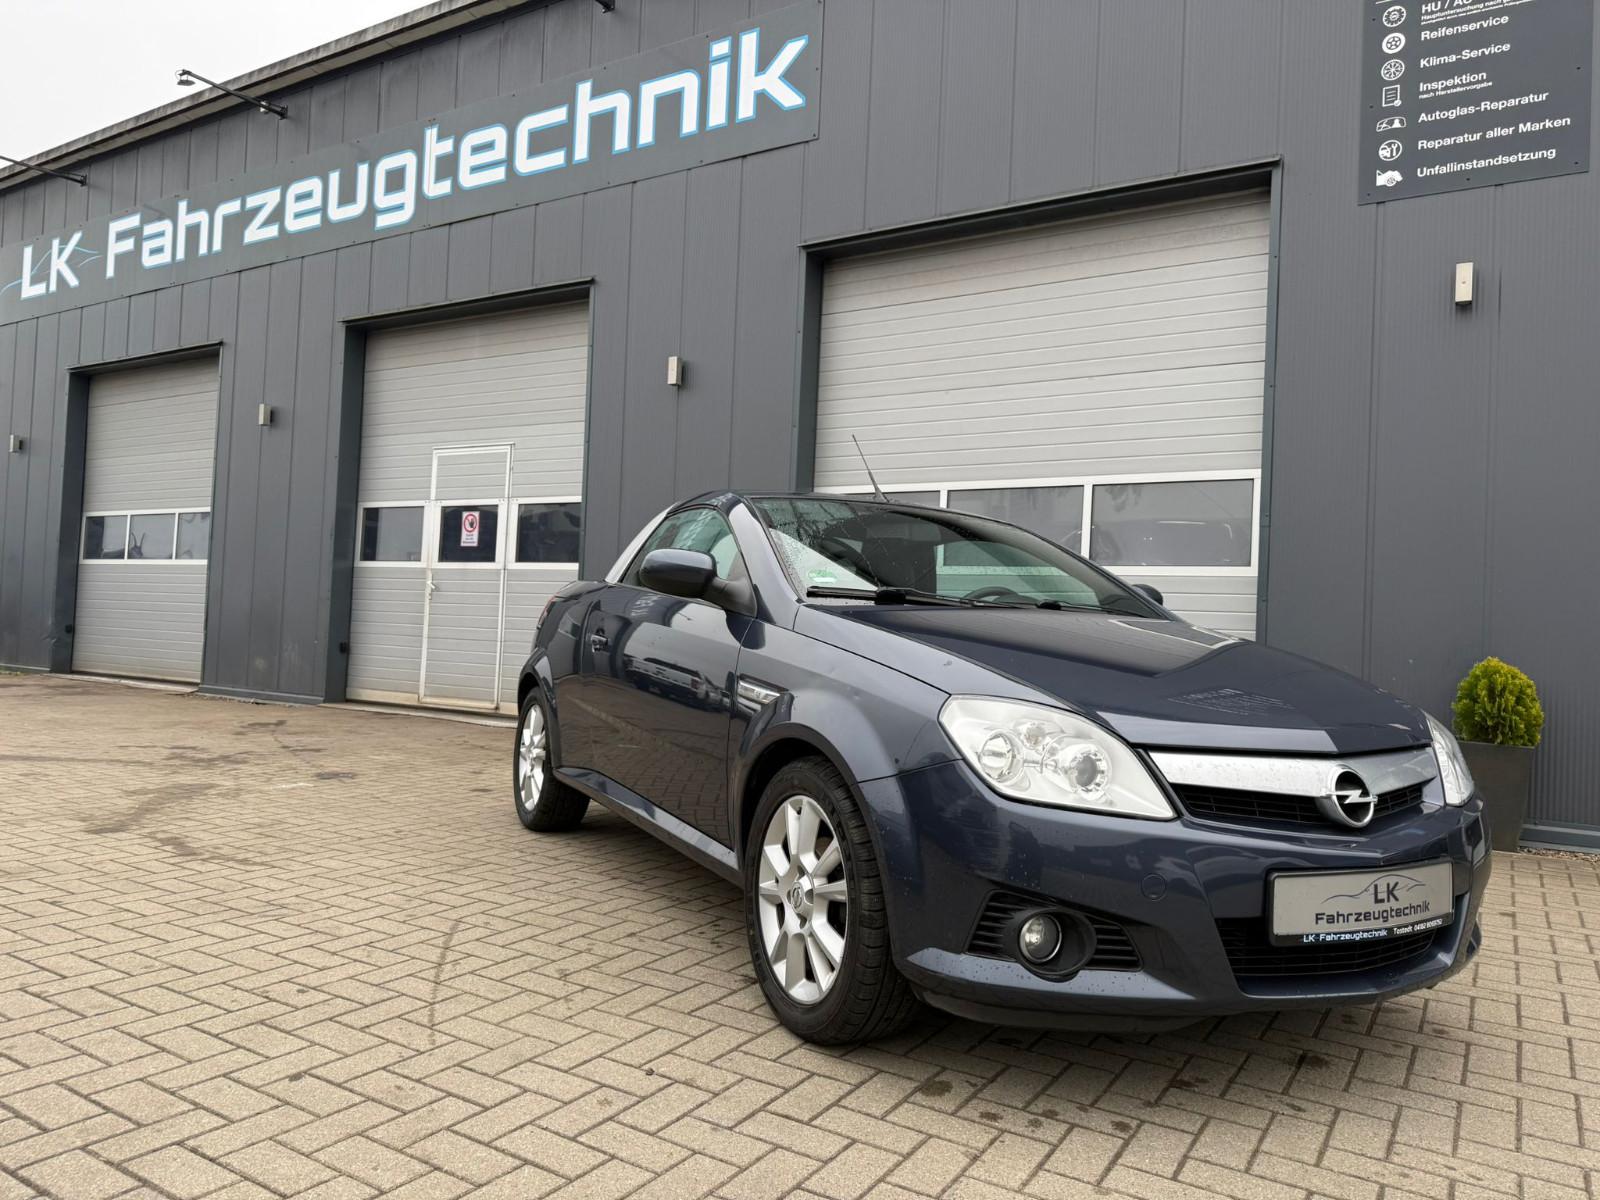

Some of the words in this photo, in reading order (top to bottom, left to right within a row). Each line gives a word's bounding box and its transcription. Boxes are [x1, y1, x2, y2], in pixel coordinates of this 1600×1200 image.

[1421, 1, 1441, 14] HU
[1421, 3, 1484, 20] Hauptuntersuchung
[1421, 15, 1510, 41] Reifenservice
[1420, 43, 1511, 69] Klima-Service
[1419, 72, 1487, 92] Inspektion
[1418, 92, 1550, 123] Autoglas-Reparatur
[1417, 132, 1483, 150] Reparatur
[1485, 126, 1515, 140] aller
[1518, 117, 1571, 134] Marken
[21, 231, 83, 300] LK
[105, 27, 809, 280] Fahrzeugtechnik
[1417, 148, 1557, 177] Unfallinstandsetzung
[1373, 881, 1400, 905] LK
[1315, 900, 1431, 925] Fahrzeugtechnik
[1319, 928, 1388, 942] Fahrzeugtechnik
